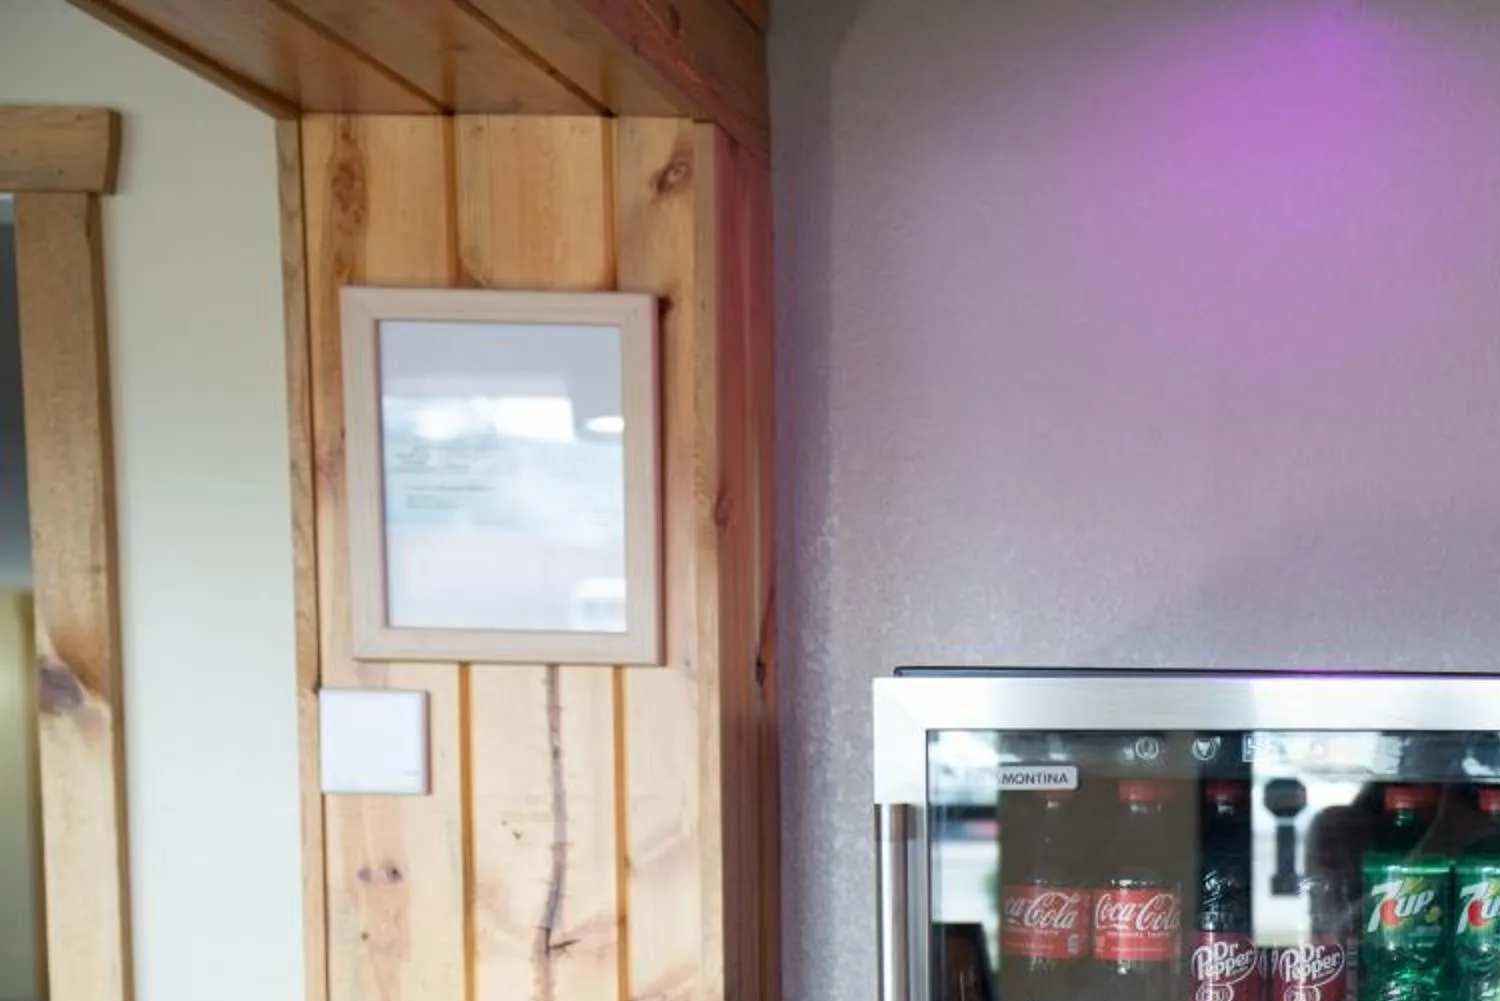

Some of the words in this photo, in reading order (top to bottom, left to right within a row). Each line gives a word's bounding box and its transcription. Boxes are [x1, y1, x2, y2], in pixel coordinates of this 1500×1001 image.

[1195, 945, 1252, 981] Pepper
[1213, 941, 1239, 960] Dr
[1300, 943, 1326, 962] Dr
[1282, 948, 1342, 983] Pepper
